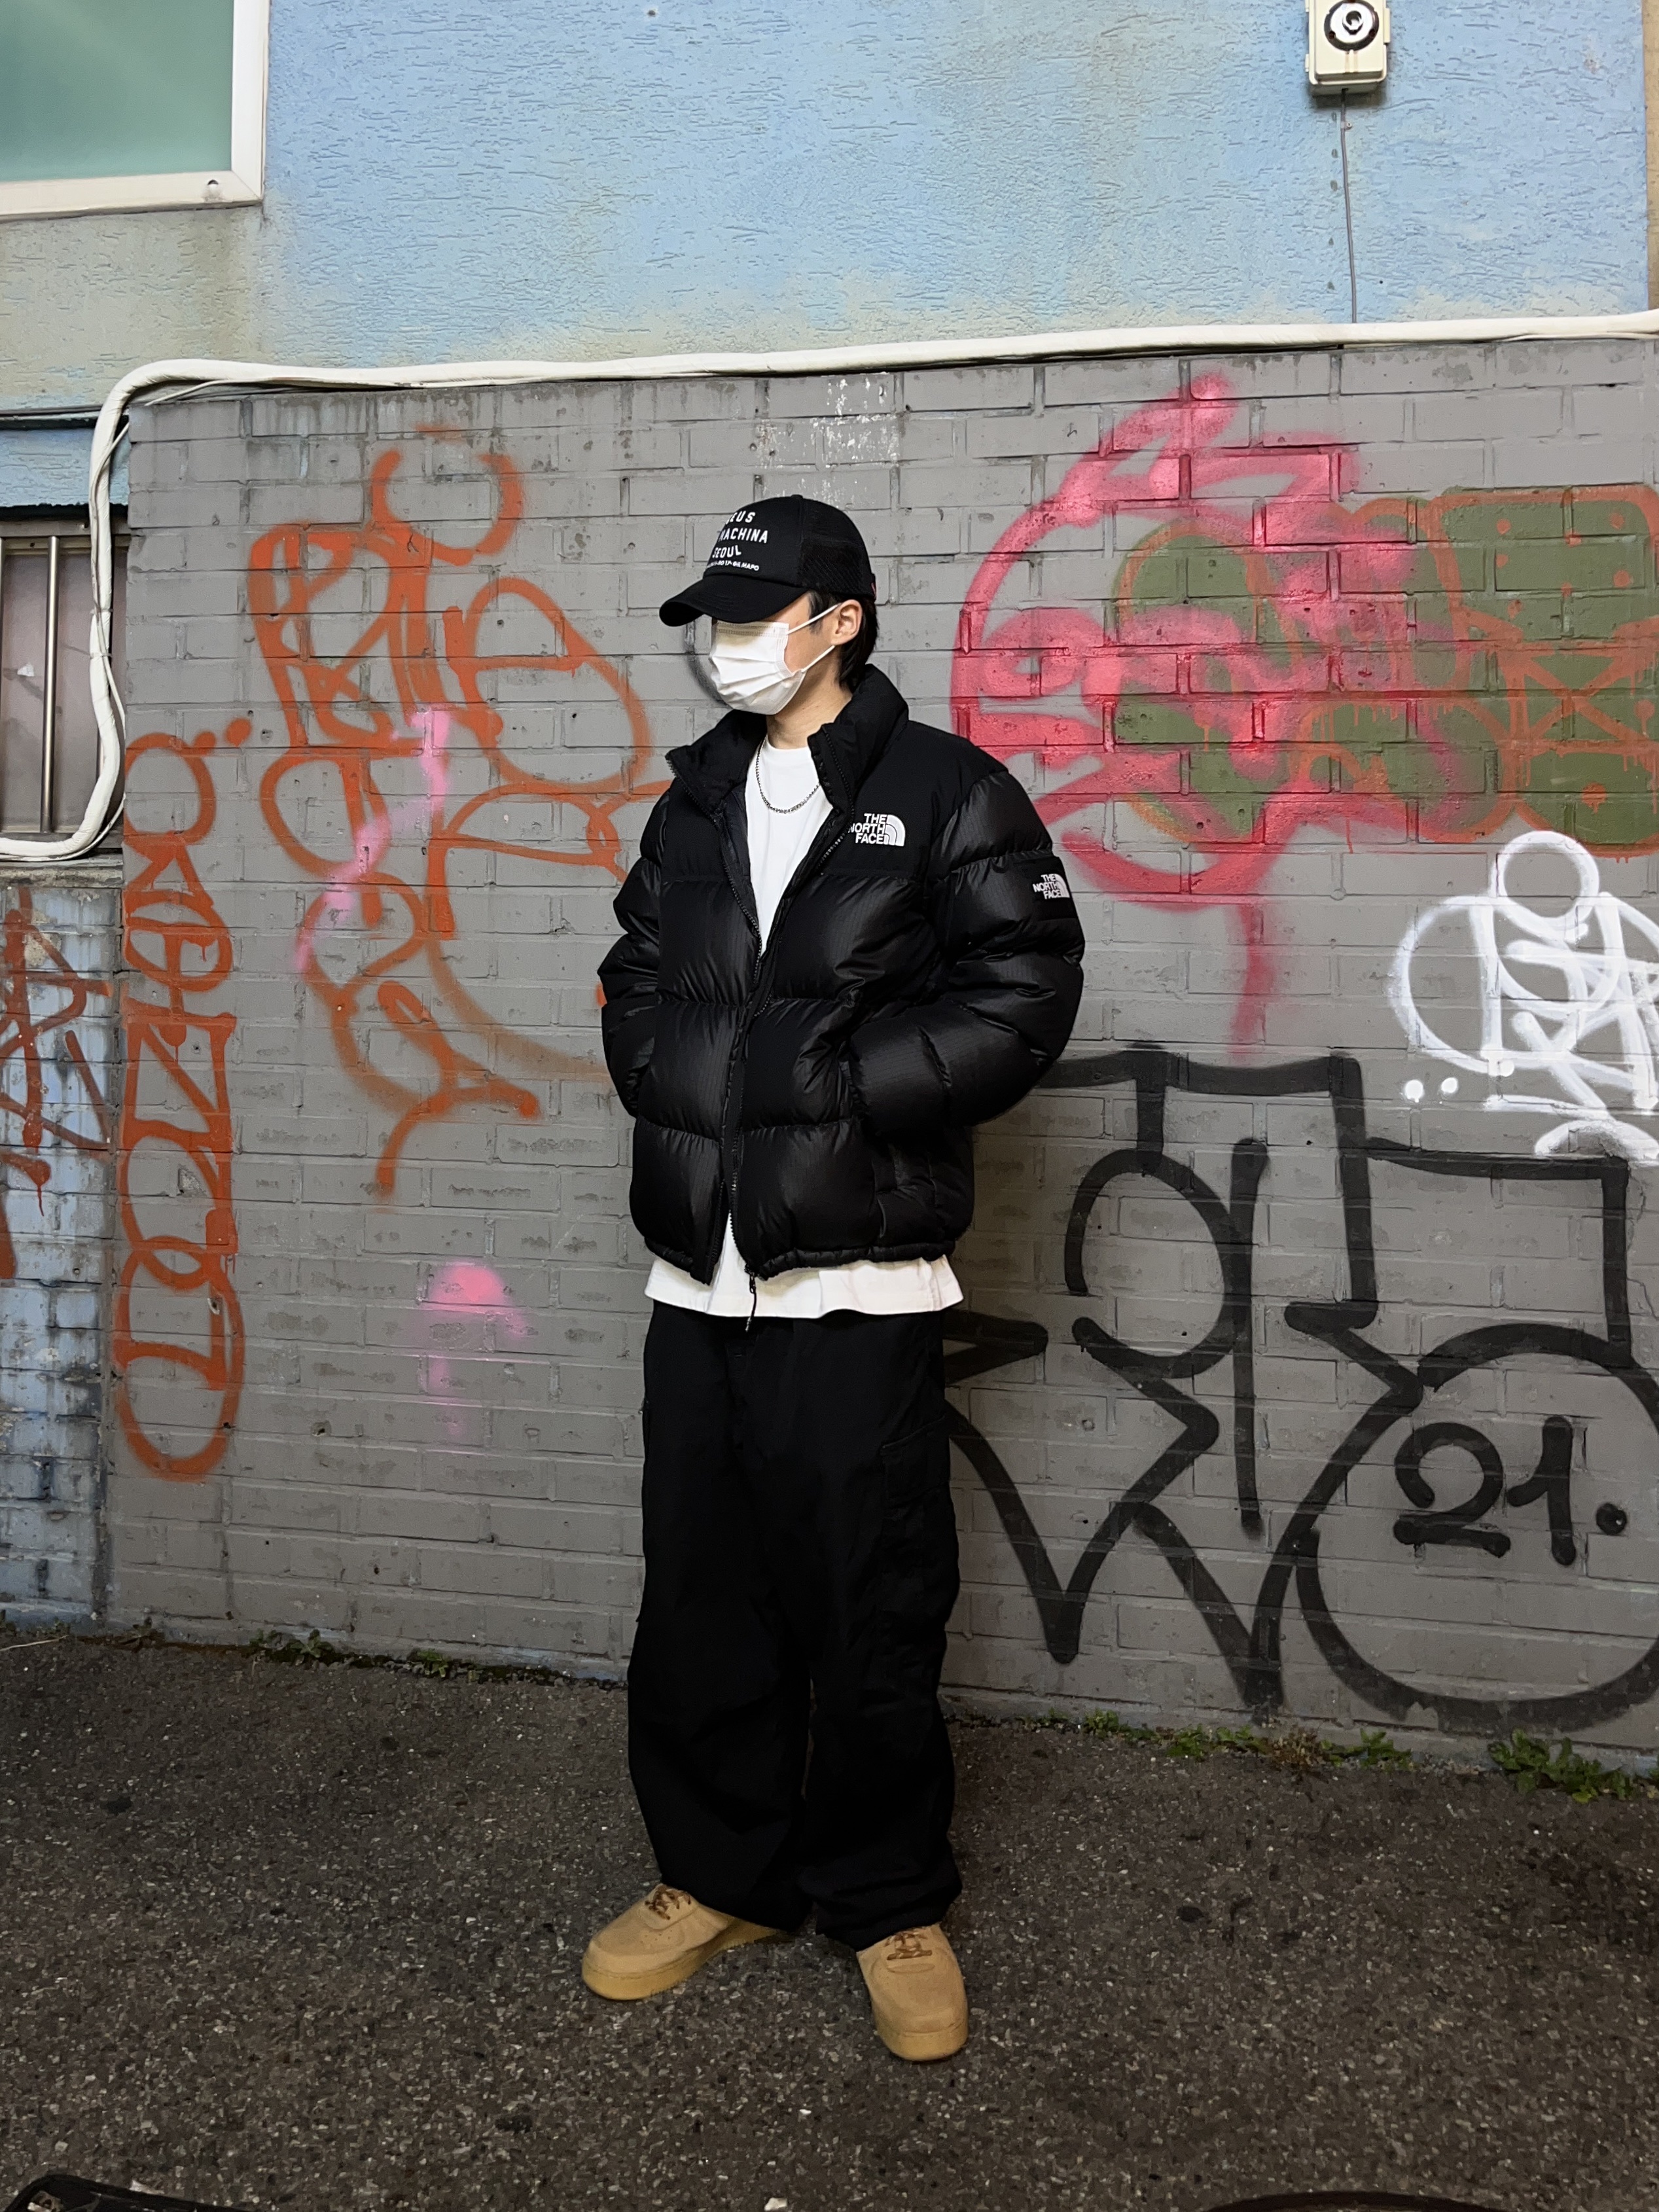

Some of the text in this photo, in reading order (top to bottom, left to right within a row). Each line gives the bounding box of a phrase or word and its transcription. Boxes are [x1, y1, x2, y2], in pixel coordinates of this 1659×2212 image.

[726, 510, 756, 524] EUS
[719, 527, 768, 543] MACHINA
[712, 544, 741, 558] SEOUL
[741, 562, 759, 571] MAPO
[864, 813, 887, 824] THE
[855, 832, 884, 844] FACE
[1041, 874, 1056, 882] THE
[1033, 882, 1058, 893] NORTH
[1043, 889, 1061, 899] FACE
